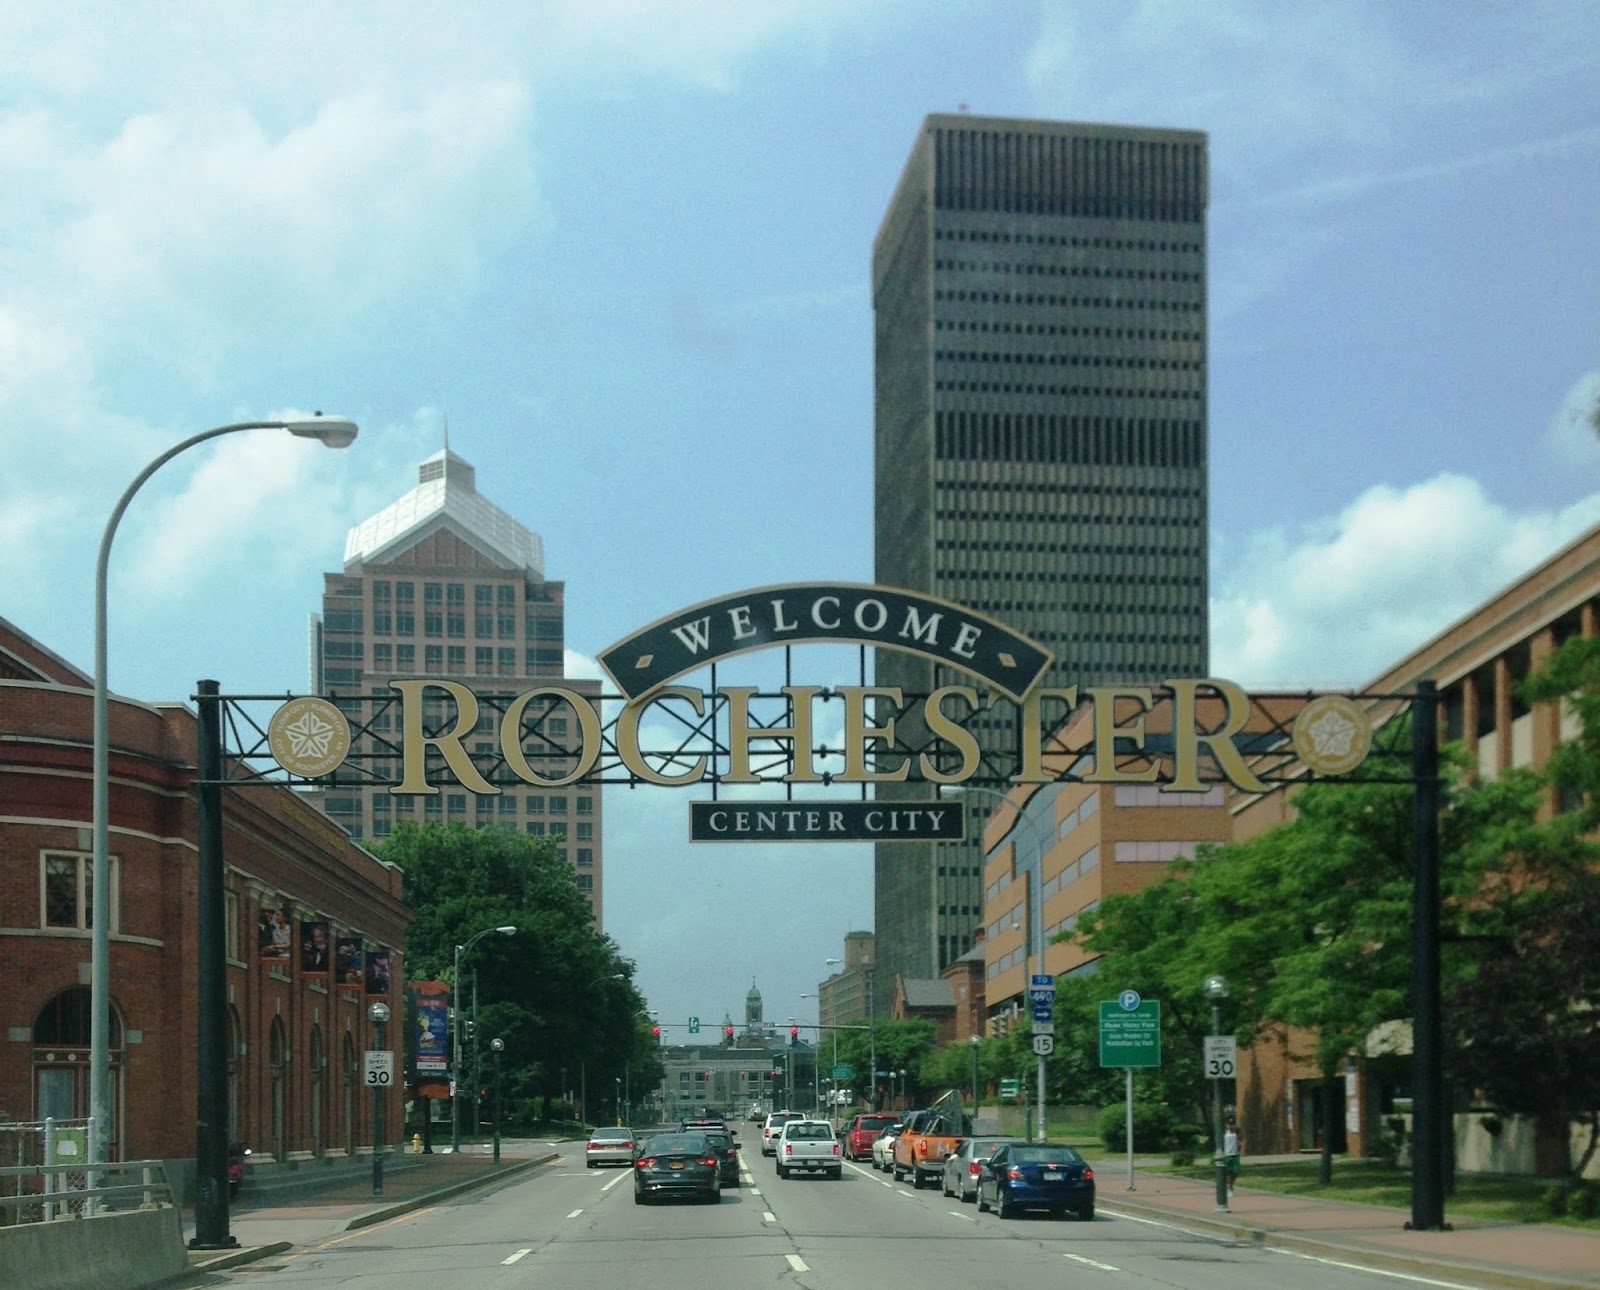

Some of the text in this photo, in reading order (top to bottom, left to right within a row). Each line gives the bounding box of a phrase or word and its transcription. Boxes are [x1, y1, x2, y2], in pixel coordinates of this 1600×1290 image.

[671, 596, 982, 659] WELCOME
[389, 678, 1274, 795] ROCHESTER
[709, 810, 946, 832] CENTER CITY
[1037, 976, 1048, 984] TO
[1033, 992, 1053, 1002] 490
[1124, 993, 1136, 1008] P
[1036, 1039, 1050, 1051] 15
[1210, 1060, 1233, 1075] 30
[368, 1071, 389, 1083] 30
